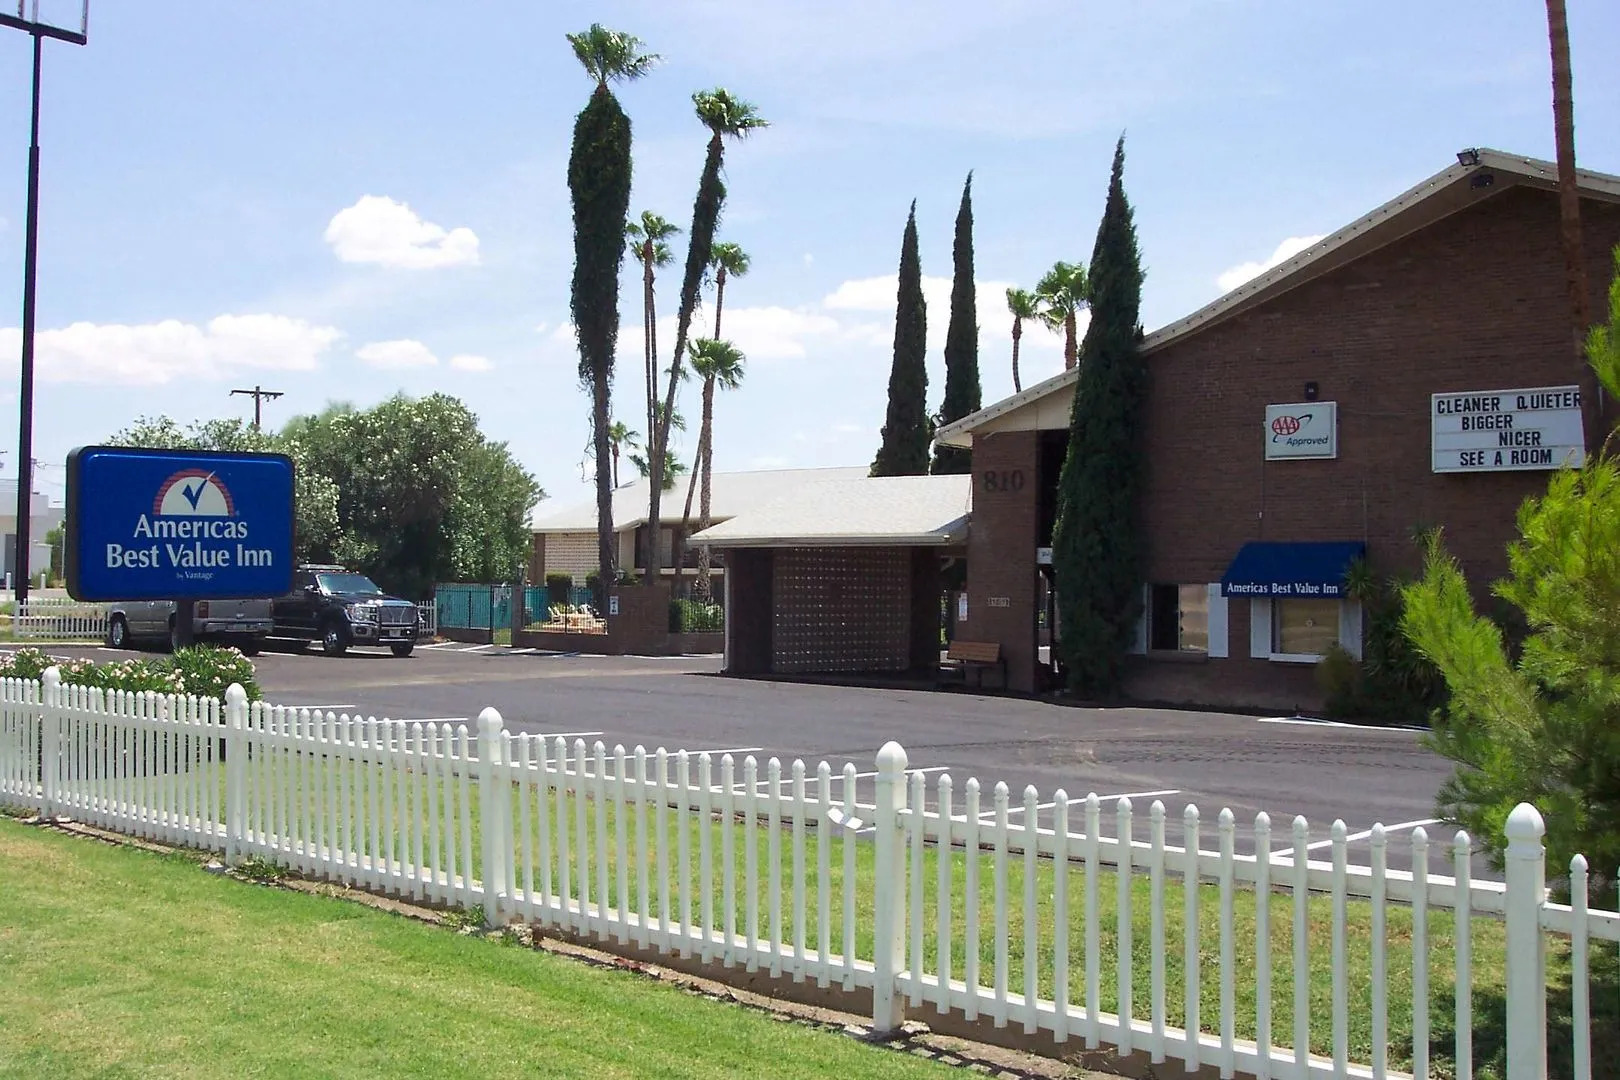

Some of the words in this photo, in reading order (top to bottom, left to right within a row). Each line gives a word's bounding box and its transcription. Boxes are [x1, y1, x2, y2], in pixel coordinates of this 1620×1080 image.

[1437, 396, 1500, 414] CLEANER
[1516, 392, 1581, 410] QUIETER
[1272, 416, 1299, 435] AAA
[1461, 414, 1513, 430] BIGGER
[1286, 435, 1329, 447] Approved
[1499, 431, 1541, 446] NICER
[1460, 451, 1484, 466] SEE
[1494, 450, 1502, 465] A
[1511, 449, 1552, 464] ROOM
[984, 470, 1024, 491] 810
[133, 513, 248, 539] Americas
[106, 543, 160, 568] Best
[165, 541, 230, 568] Value
[237, 543, 272, 567] Inn
[184, 571, 214, 581] Vantage
[1227, 582, 1268, 593] Americas
[1271, 583, 1291, 593] Best
[1294, 583, 1320, 594] Value
[1323, 583, 1338, 594] Inn
